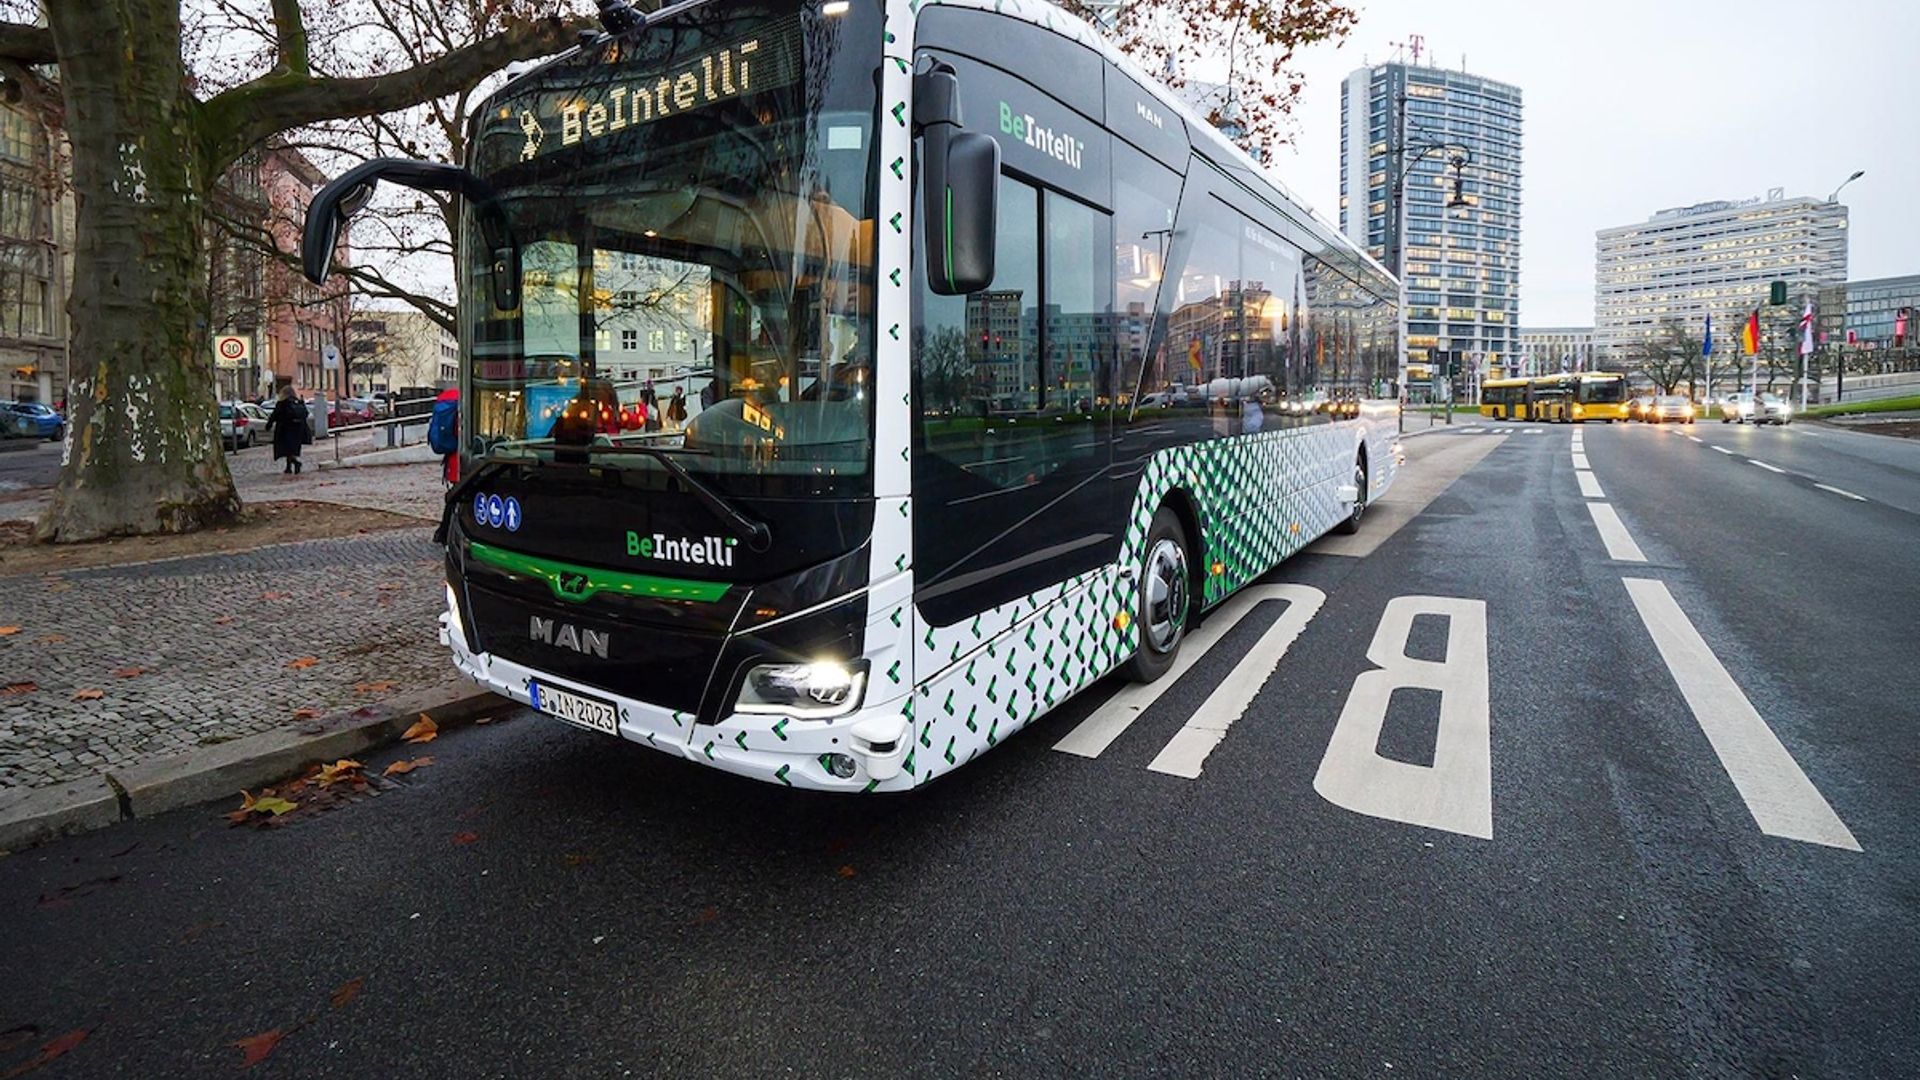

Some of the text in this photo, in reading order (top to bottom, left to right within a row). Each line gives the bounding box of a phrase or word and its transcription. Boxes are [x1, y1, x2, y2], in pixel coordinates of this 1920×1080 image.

[562, 40, 758, 146] BeIntelli
[1136, 101, 1163, 129] MAN
[1000, 101, 1084, 170] BeIntelli
[225, 343, 240, 355] 30
[626, 531, 738, 567] BeIntelli
[529, 615, 609, 659] MAN
[576, 700, 614, 731] 2023
